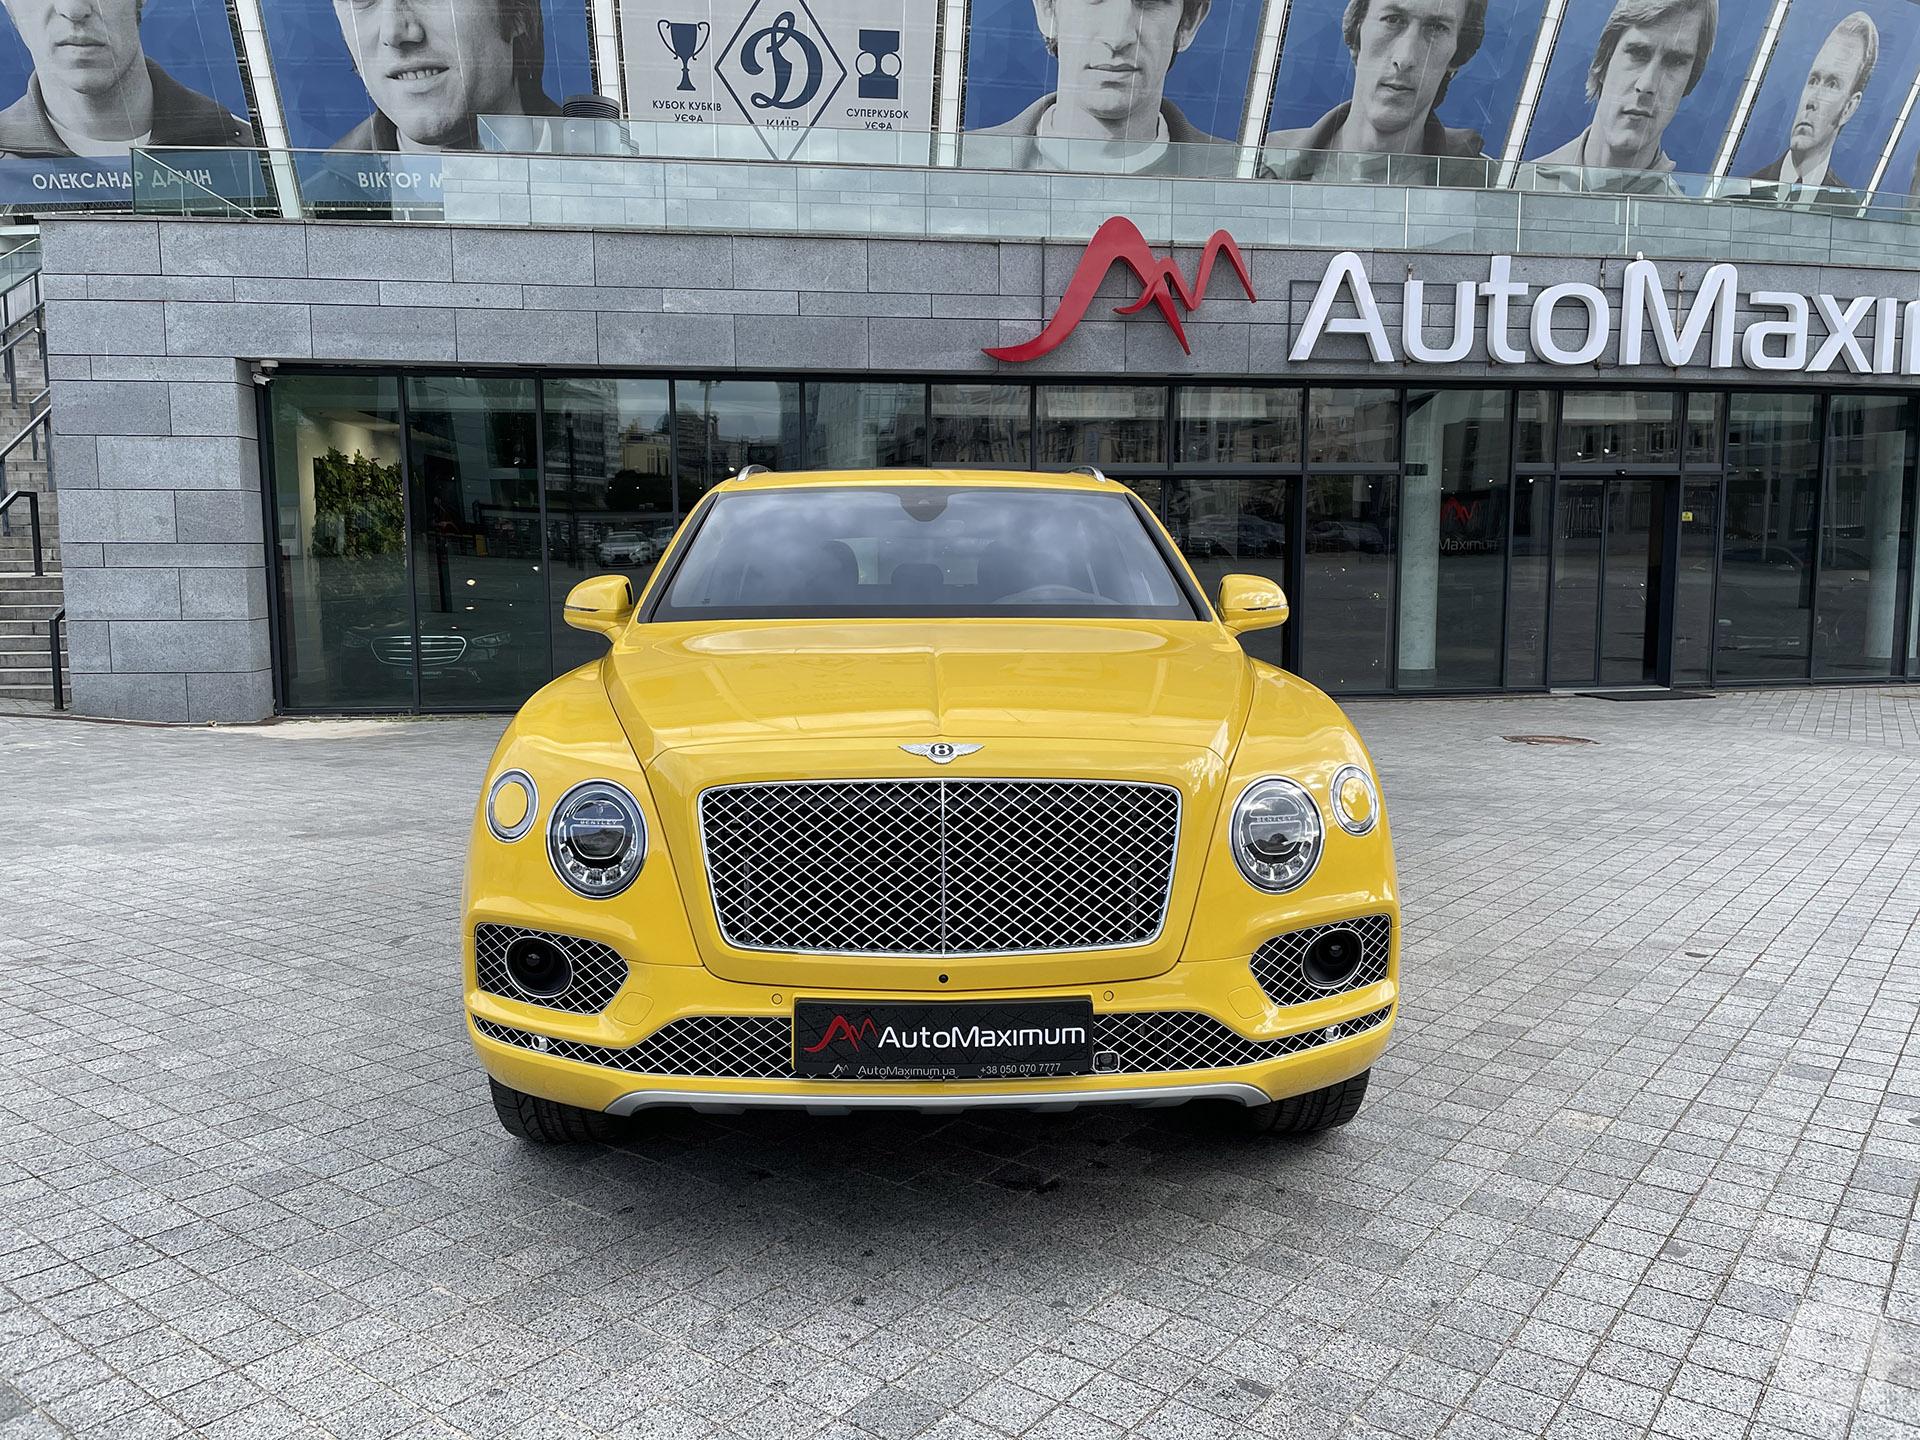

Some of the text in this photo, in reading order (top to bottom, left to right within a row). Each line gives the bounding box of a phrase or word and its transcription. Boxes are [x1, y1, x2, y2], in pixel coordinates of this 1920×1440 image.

[652, 100, 722, 112] КУБОК КУБКІВ
[674, 113, 704, 122] УЄФА
[846, 108, 909, 119] СУПЕРКУБОК
[865, 121, 893, 130] УЄФА
[32, 171, 144, 190] ОЛЕКСАНДР
[358, 172, 422, 188] ВІКТОР
[1288, 251, 1920, 375] AutoMaxi
[877, 1026, 1086, 1049] AutoMaximum
[858, 1065, 956, 1076] AutoMaximum.ua
[980, 1065, 998, 1075] +38
[1000, 1064, 1017, 1074] 050
[1019, 1063, 1037, 1073] 070
[1039, 1063, 1061, 1072] 7777
